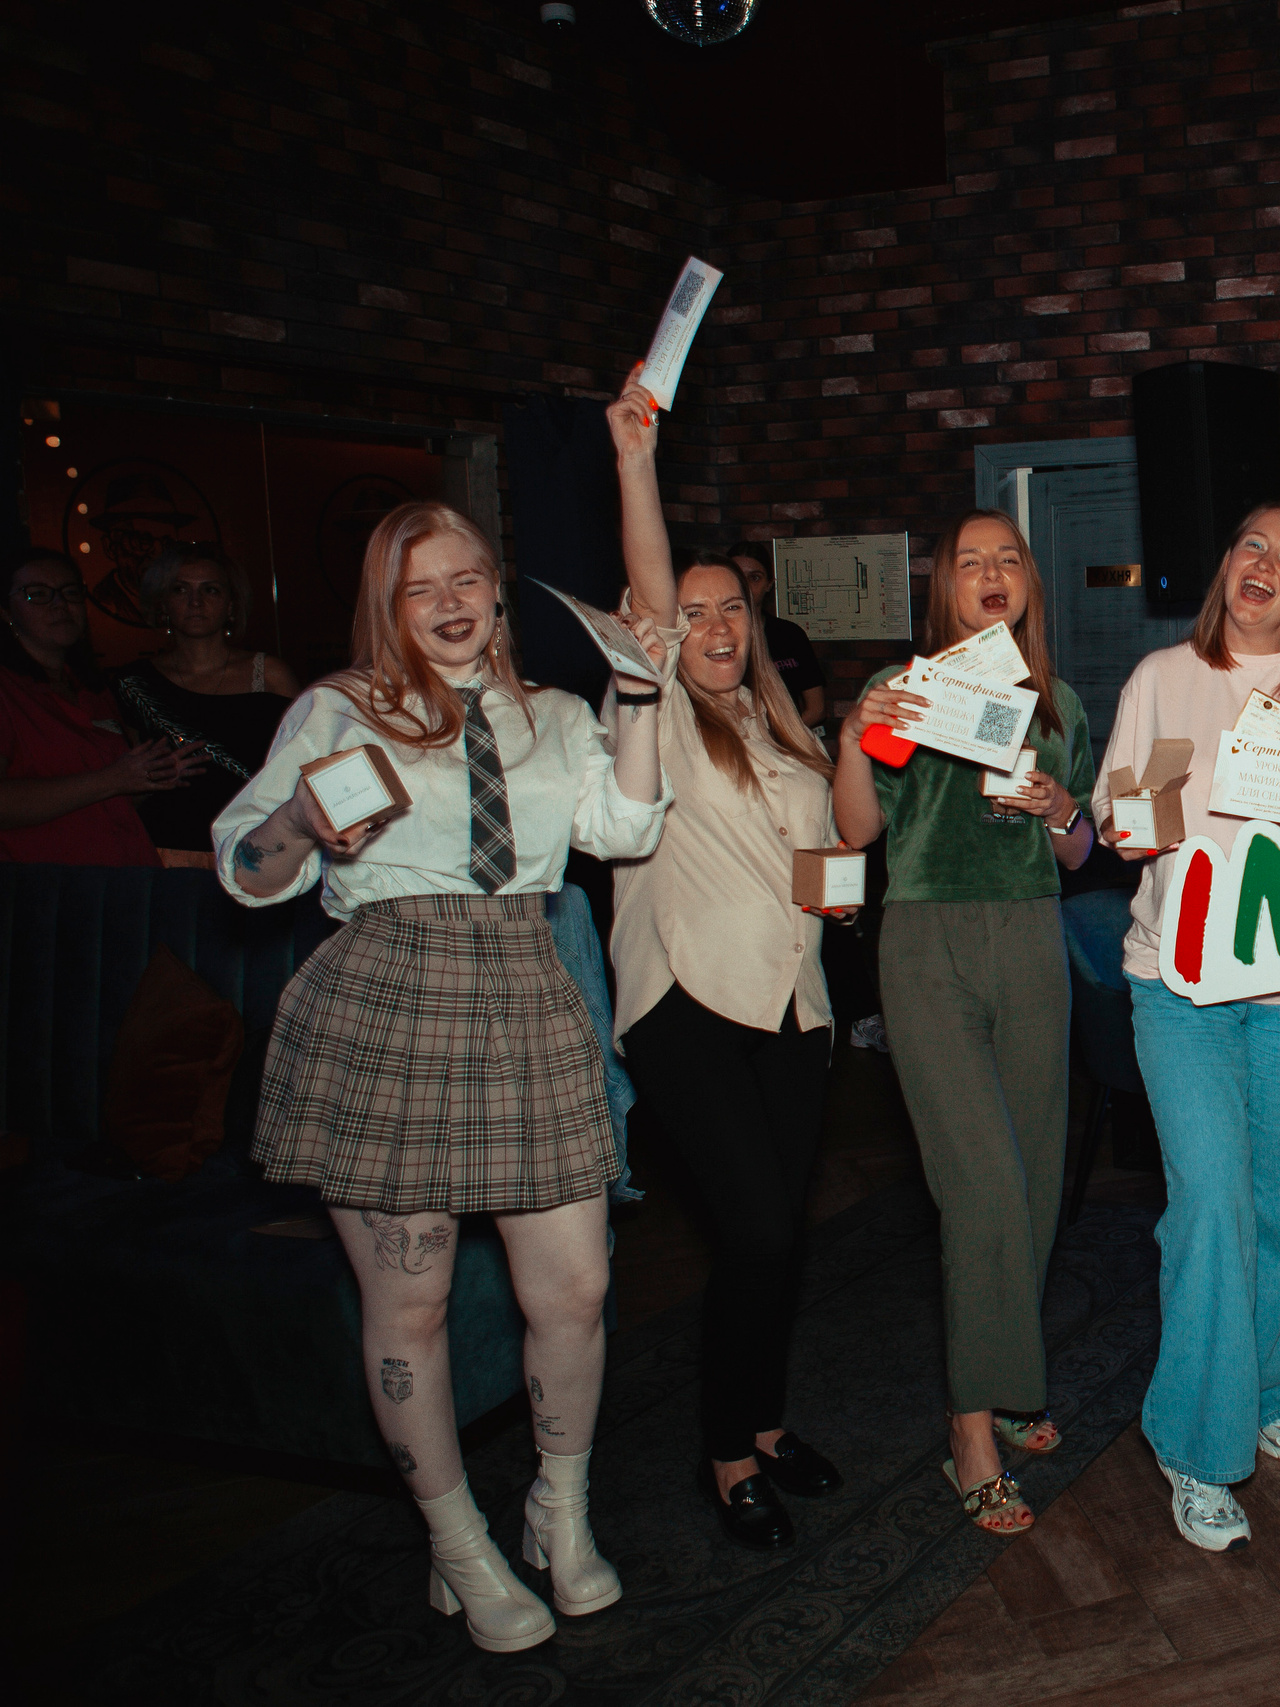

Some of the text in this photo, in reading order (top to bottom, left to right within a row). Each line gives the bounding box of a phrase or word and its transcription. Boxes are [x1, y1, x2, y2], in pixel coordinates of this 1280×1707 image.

[933, 671, 1012, 702] Сертификат
[942, 690, 969, 706] УРОК
[945, 720, 969, 736] СЕБЯ
[1236, 786, 1260, 799] ДЛЯ
